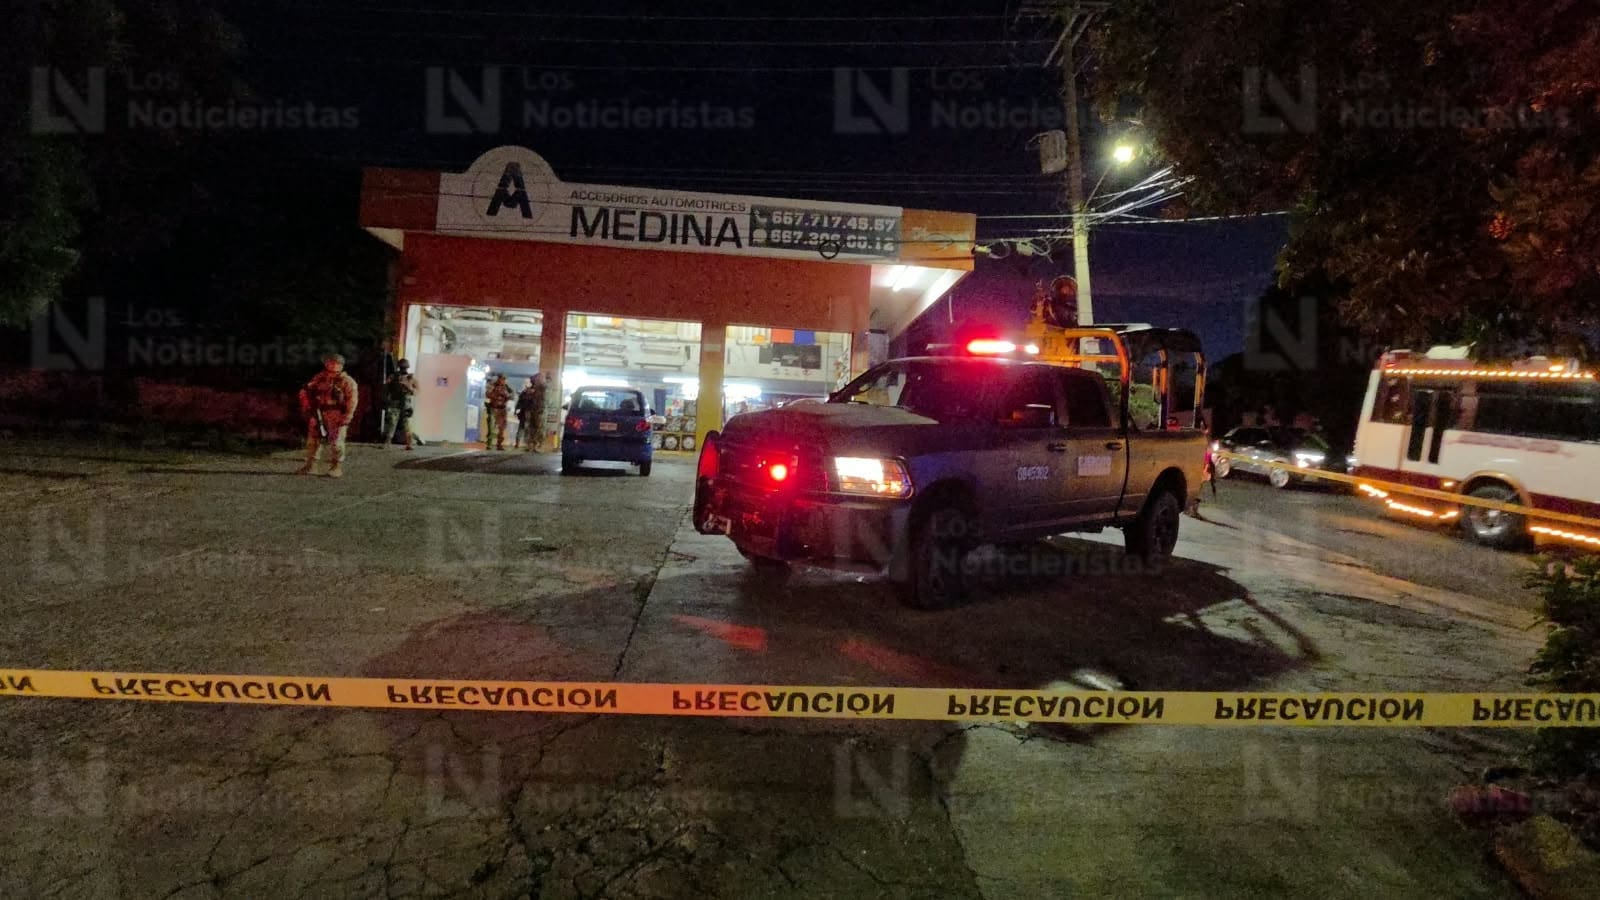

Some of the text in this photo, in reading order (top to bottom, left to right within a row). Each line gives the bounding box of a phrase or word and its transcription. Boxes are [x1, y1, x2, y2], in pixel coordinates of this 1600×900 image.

[570, 190, 746, 213] ACCESORIOS AUTOMOTRICES
[570, 206, 743, 249] MEDINA
